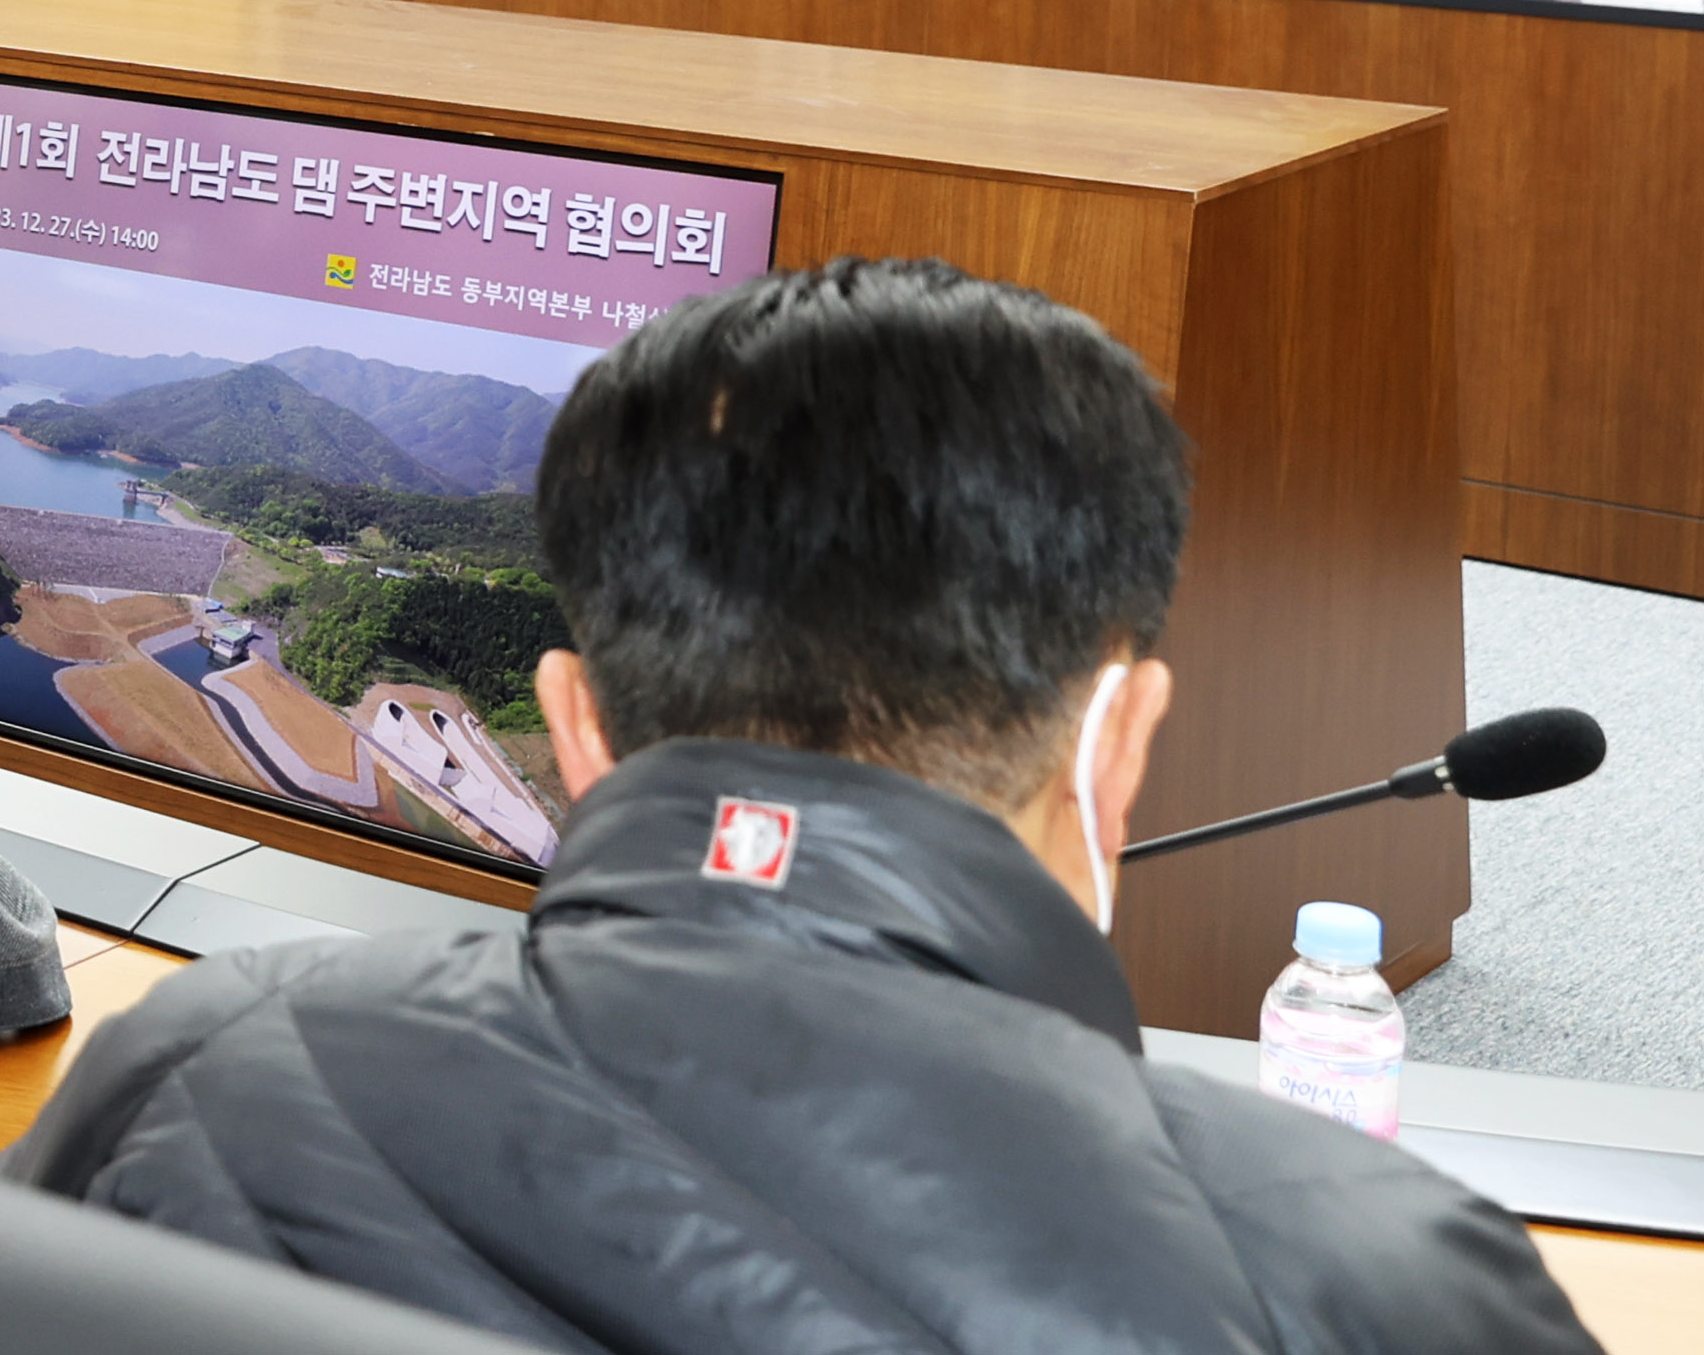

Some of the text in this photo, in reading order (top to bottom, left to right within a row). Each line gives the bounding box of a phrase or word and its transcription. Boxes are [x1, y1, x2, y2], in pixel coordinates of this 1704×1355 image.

[96, 126, 280, 208] 전라남도
[290, 151, 339, 220] 댐
[346, 162, 551, 252] 주변지역
[563, 191, 727, 276] 협의회
[22, 208, 47, 236] 12.
[110, 225, 159, 253] 14:00
[368, 259, 453, 301] 전라남도
[461, 270, 594, 321] 동부지역본부
[1279, 1075, 1358, 1107] 아이시스
